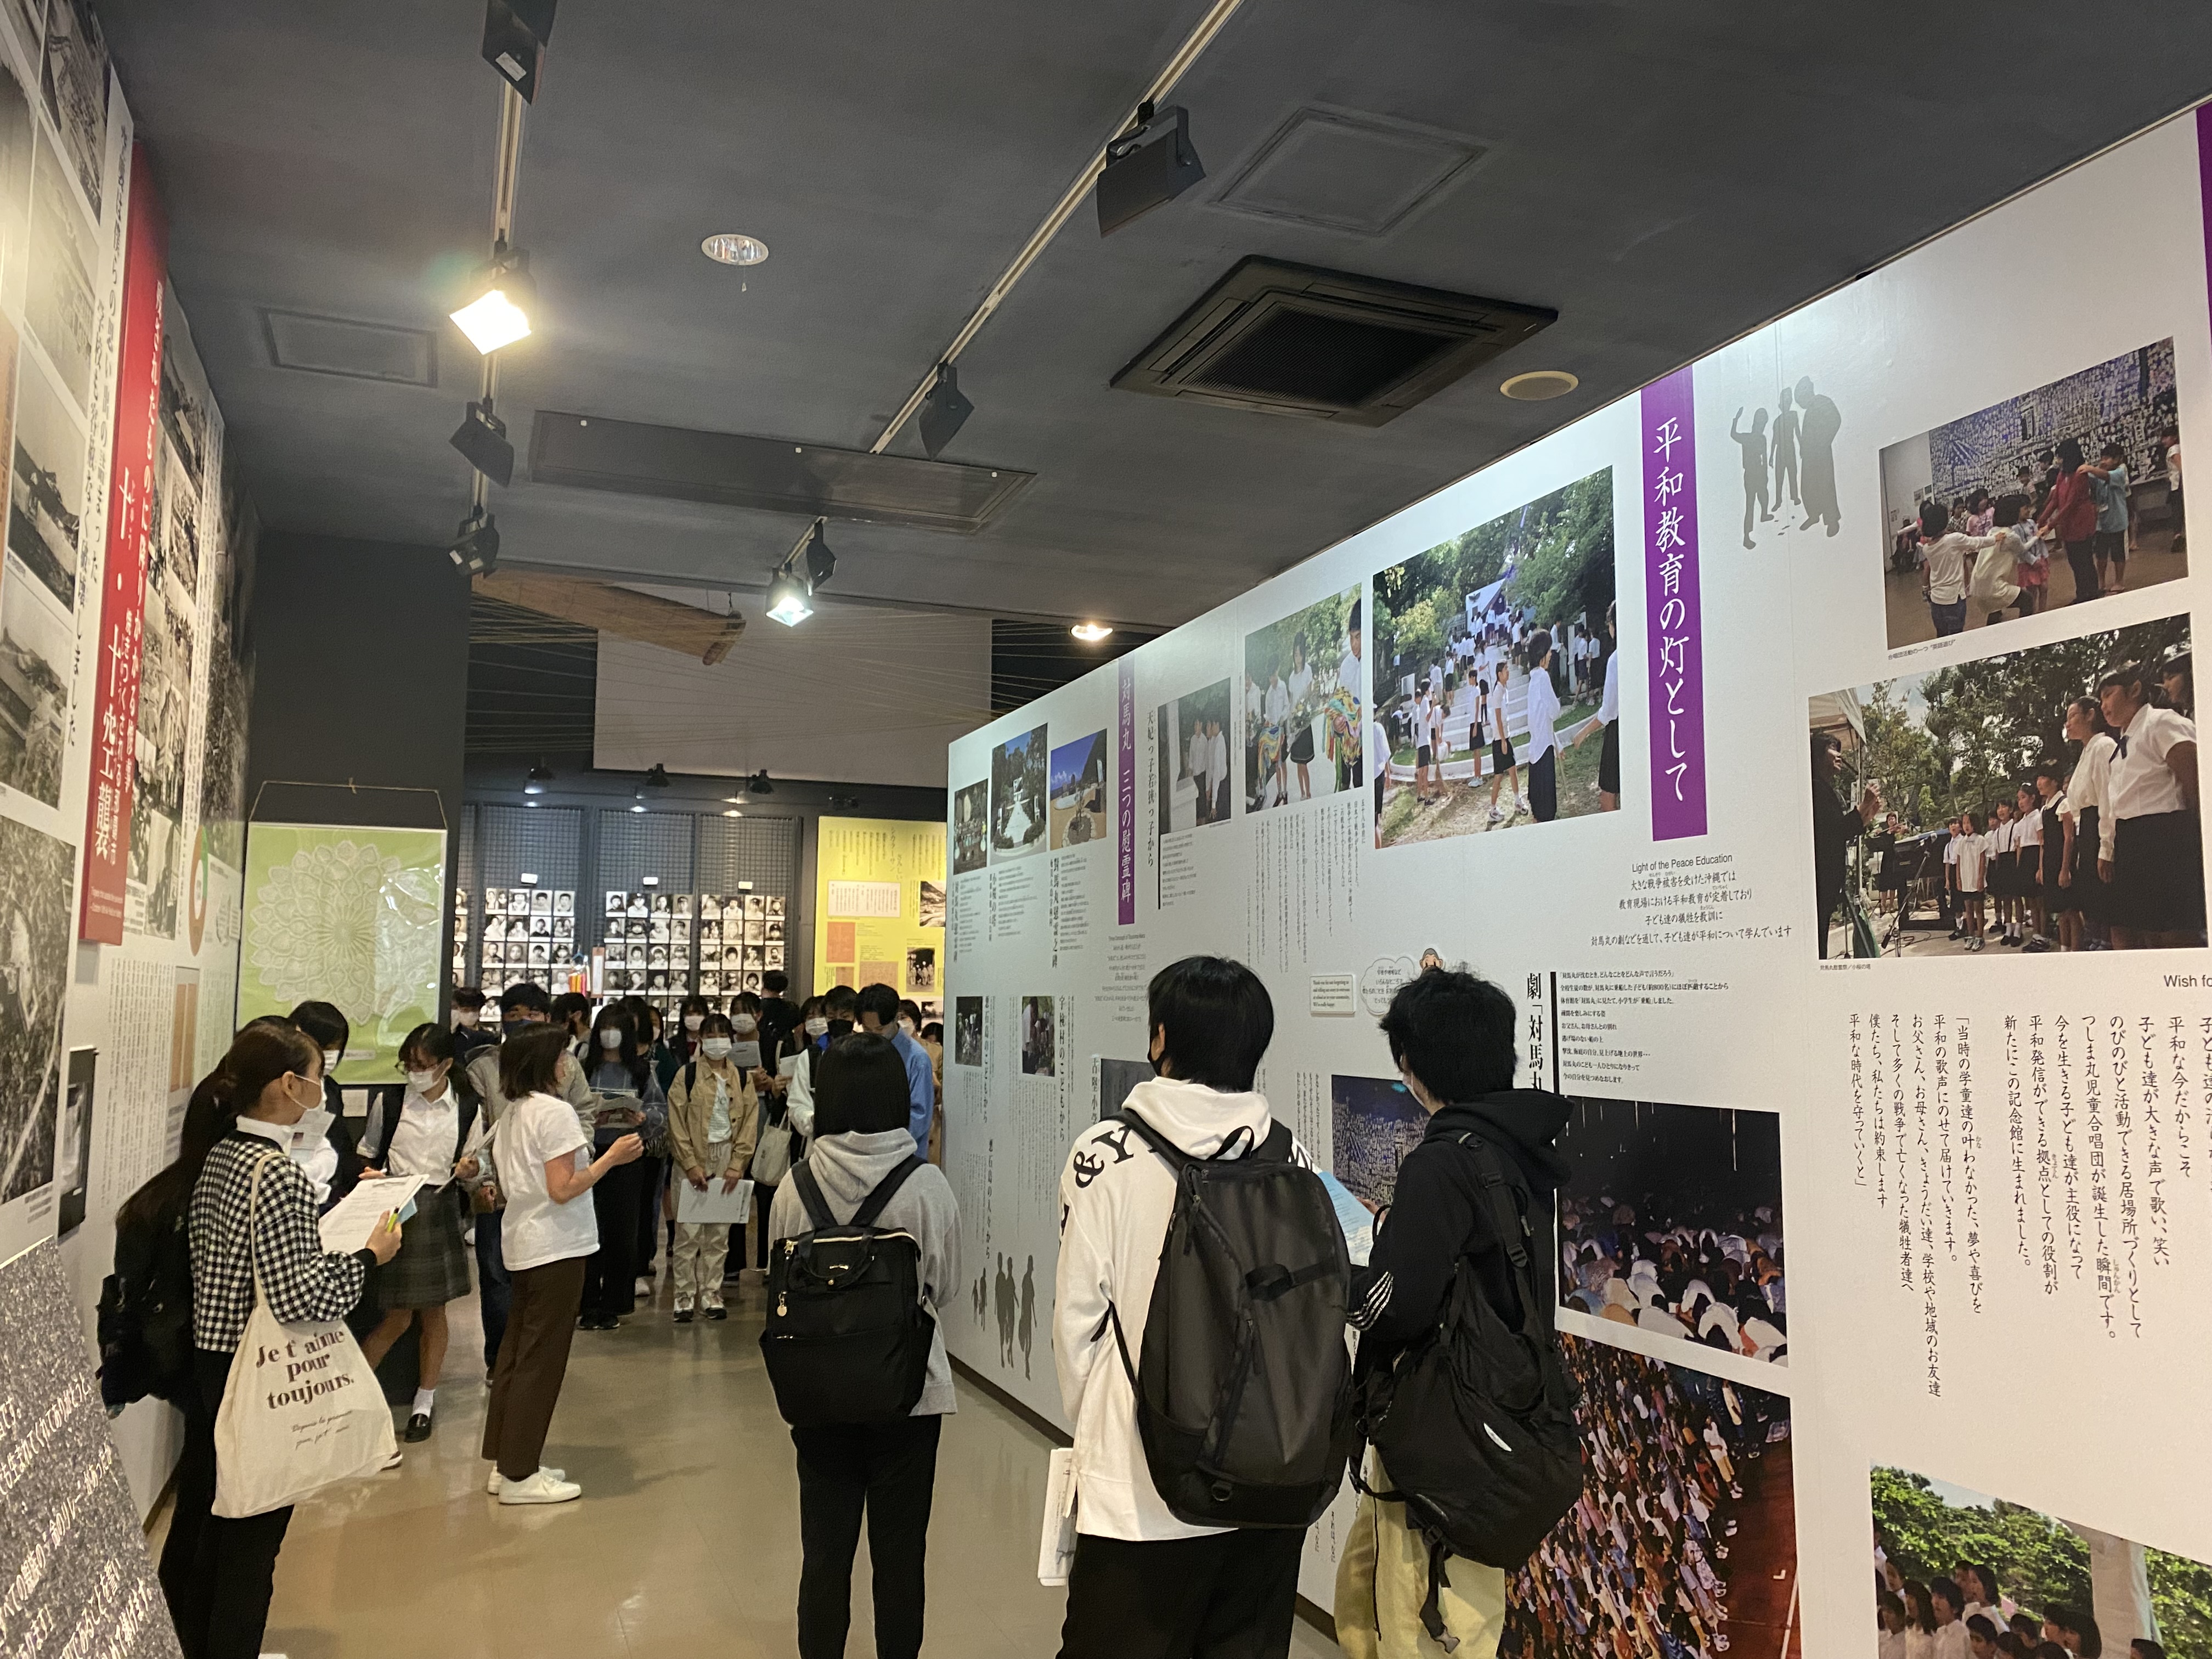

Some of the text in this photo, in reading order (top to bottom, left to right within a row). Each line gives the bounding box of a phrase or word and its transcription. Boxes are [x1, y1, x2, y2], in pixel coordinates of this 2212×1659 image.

[1654, 417, 1689, 800] 平和教育の灯として
[1592, 926, 1791, 946] 対馬丸の劇などを通して、子ども達が平和について学んでいます
[1620, 889, 1751, 909] 教育現場における平和教育が定着しており
[1631, 871, 1735, 890] 大きな戦争被害を受けた沖縄では
[1632, 854, 1733, 874] Light of the Peace Education
[1645, 911, 1723, 925] 子ども達の犠牲を教訓に
[2164, 975, 2197, 987] Wish
[1073, 1125, 1134, 1188] & Y
[1849, 1014, 1867, 1186] 平和な時代を守っていくと」
[1869, 1014, 1888, 1209] 僕たち、私たちは約束します
[1892, 1014, 1914, 1291] そして多くの戦争で亡くなった犠牲者達へ
[1934, 1014, 1957, 1261] 平和の歌声にのせて届けていきます。
[1956, 1018, 1982, 1313] 「当時の学童達の叶わなかった、夢や喜びを
[2004, 1015, 2031, 1266] 新たにこの記念館に生まれました。
[2029, 1015, 2058, 1294] 平和発信ができる拠点としての役割が
[2055, 1015, 2083, 1279] 今を生きる子ども達が主役になって
[2082, 1016, 2116, 1338] つしま丸児童合唱団が誕生した瞬間です。
[2110, 1017, 2141, 1338] のびのびと活動できる居場所づくりとして
[2139, 1017, 2169, 1265] 子ども達が大きな声で歌い、笑い
[2169, 1017, 2190, 1177] 平和な今だからこそ
[1912, 1015, 1940, 1397] お父さん、お母さん、きょうだい達、学校や地域のお友達
[256, 1345, 280, 1368] Je
[304, 1330, 345, 1354] aime
[267, 1373, 354, 1409] toujours.
[286, 1353, 330, 1383] pour
